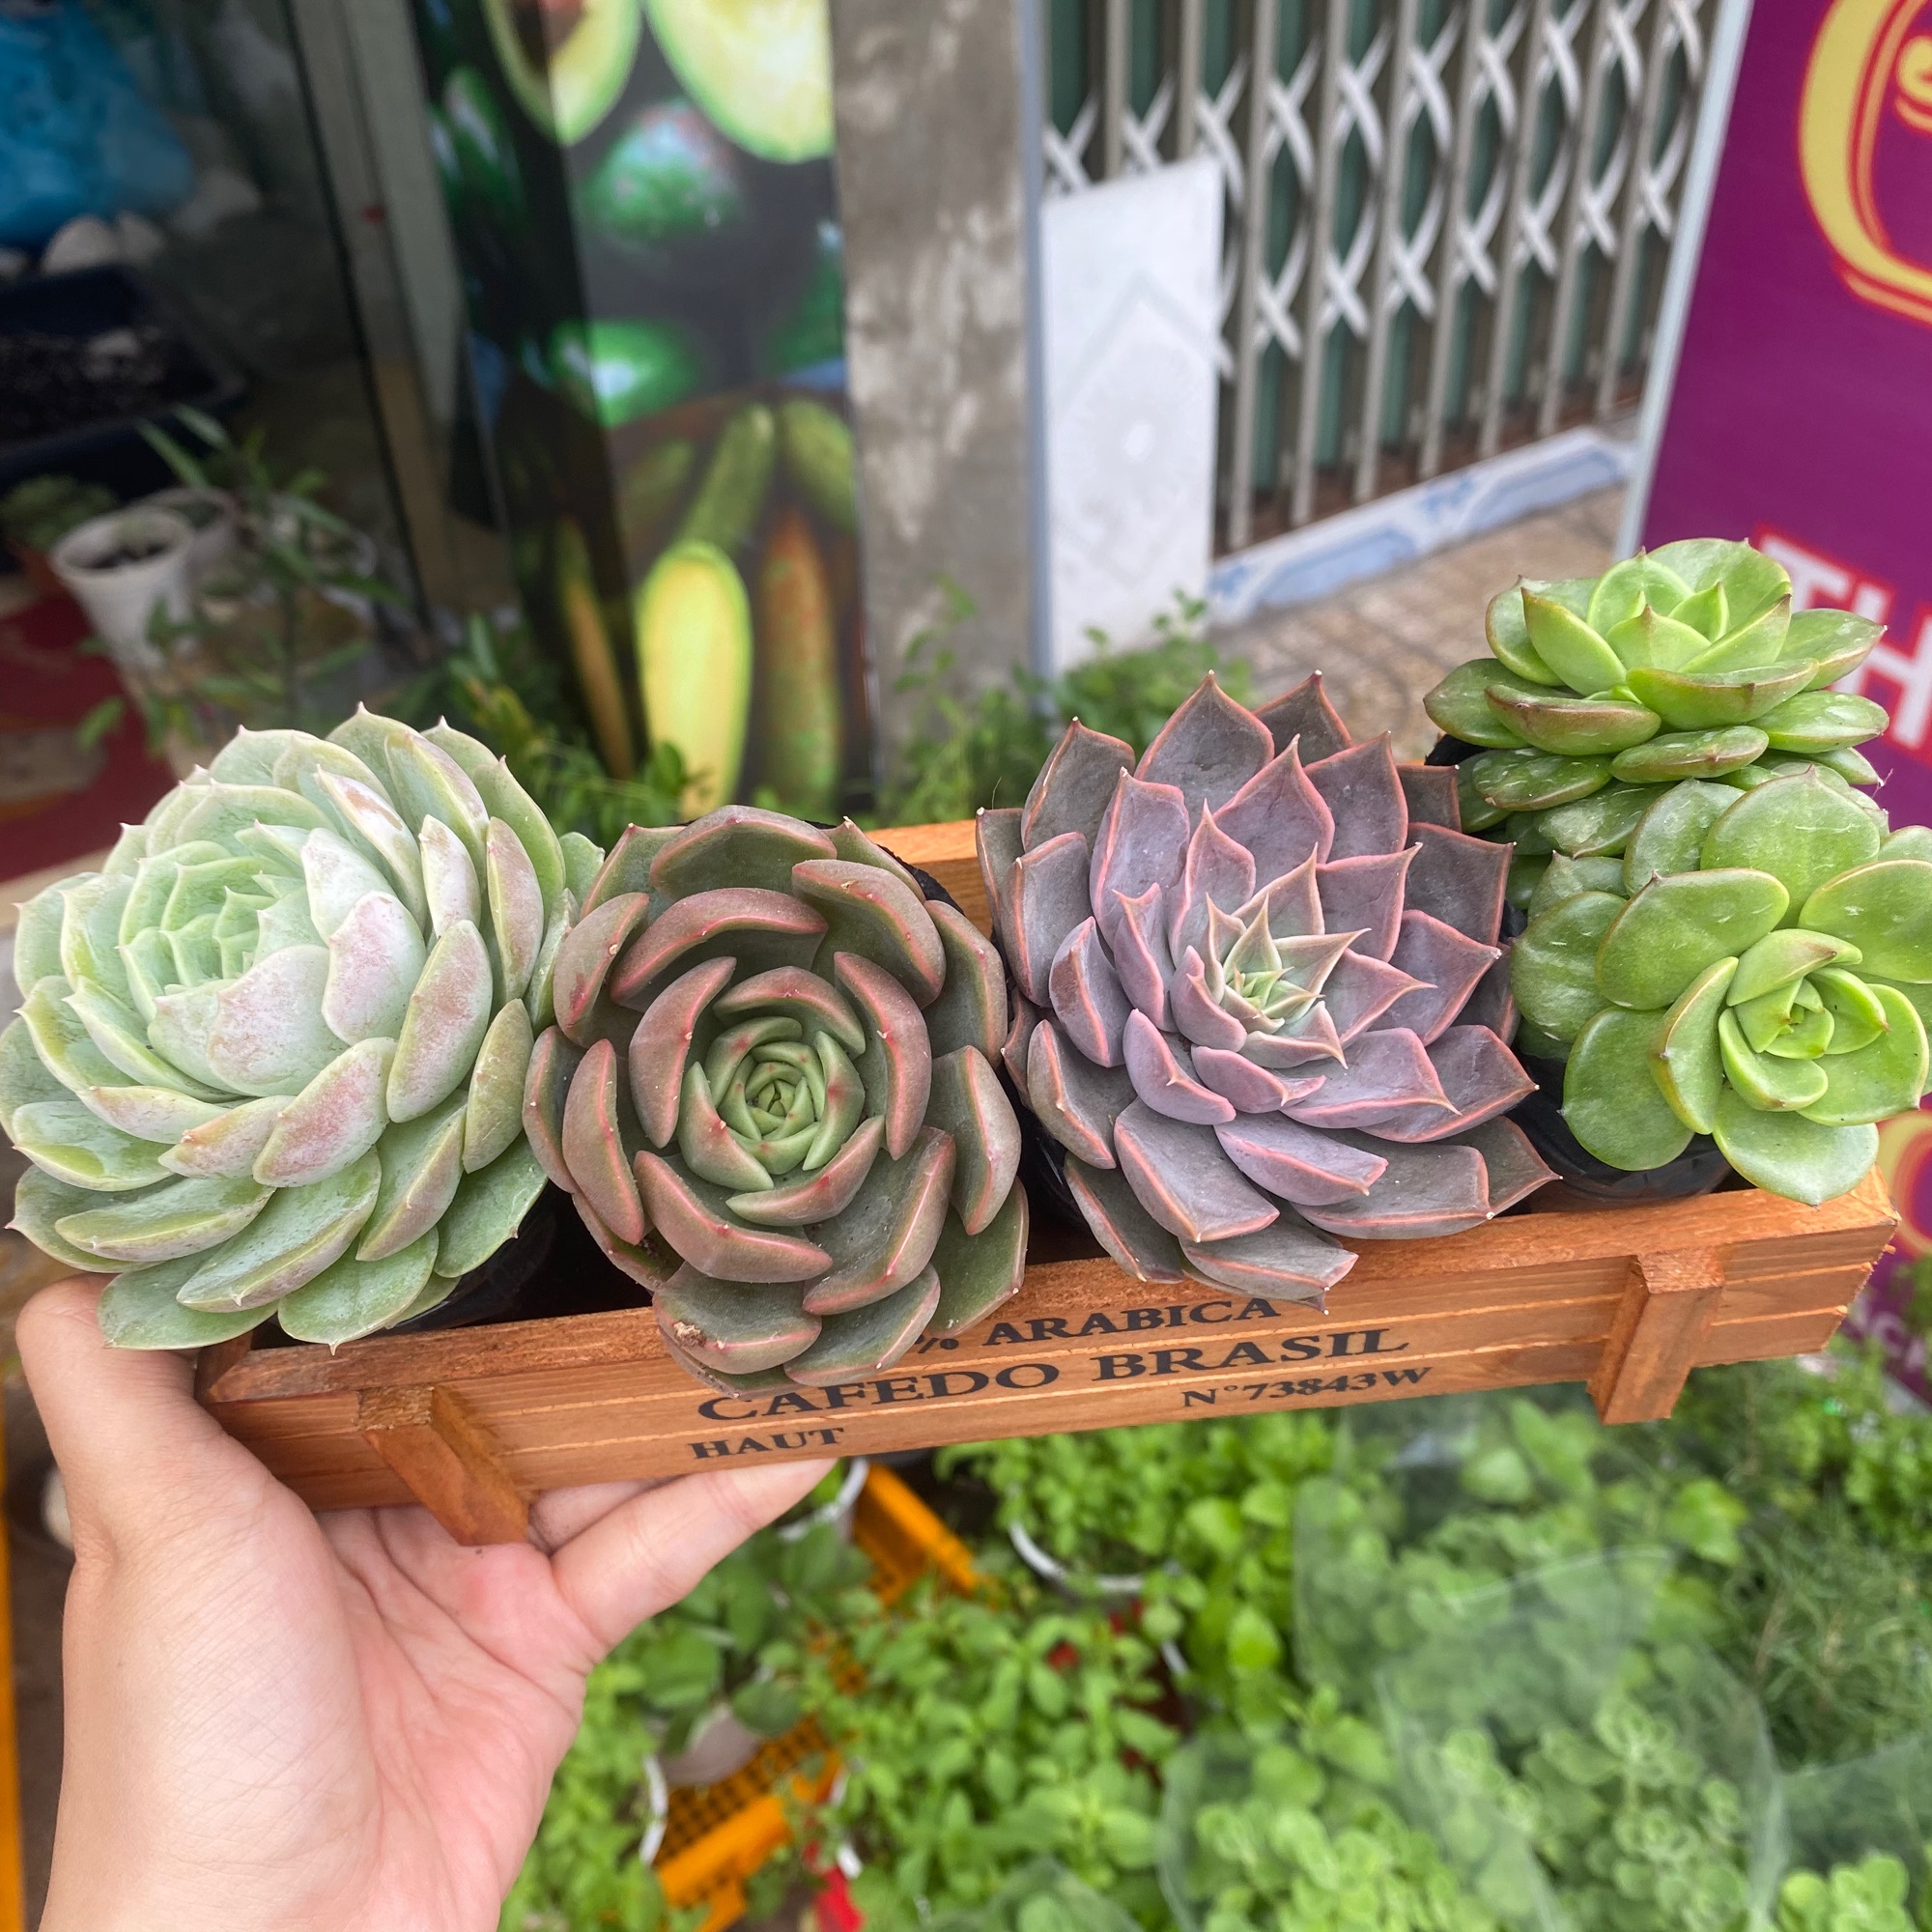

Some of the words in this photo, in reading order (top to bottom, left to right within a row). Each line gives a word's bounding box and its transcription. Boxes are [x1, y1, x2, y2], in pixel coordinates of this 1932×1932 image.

[982, 1297, 1282, 1347] ARABICA
[697, 1362, 1061, 1421] CAFEDO
[1090, 1328, 1410, 1382] BRASIL
[688, 1427, 845, 1460] HAUT
